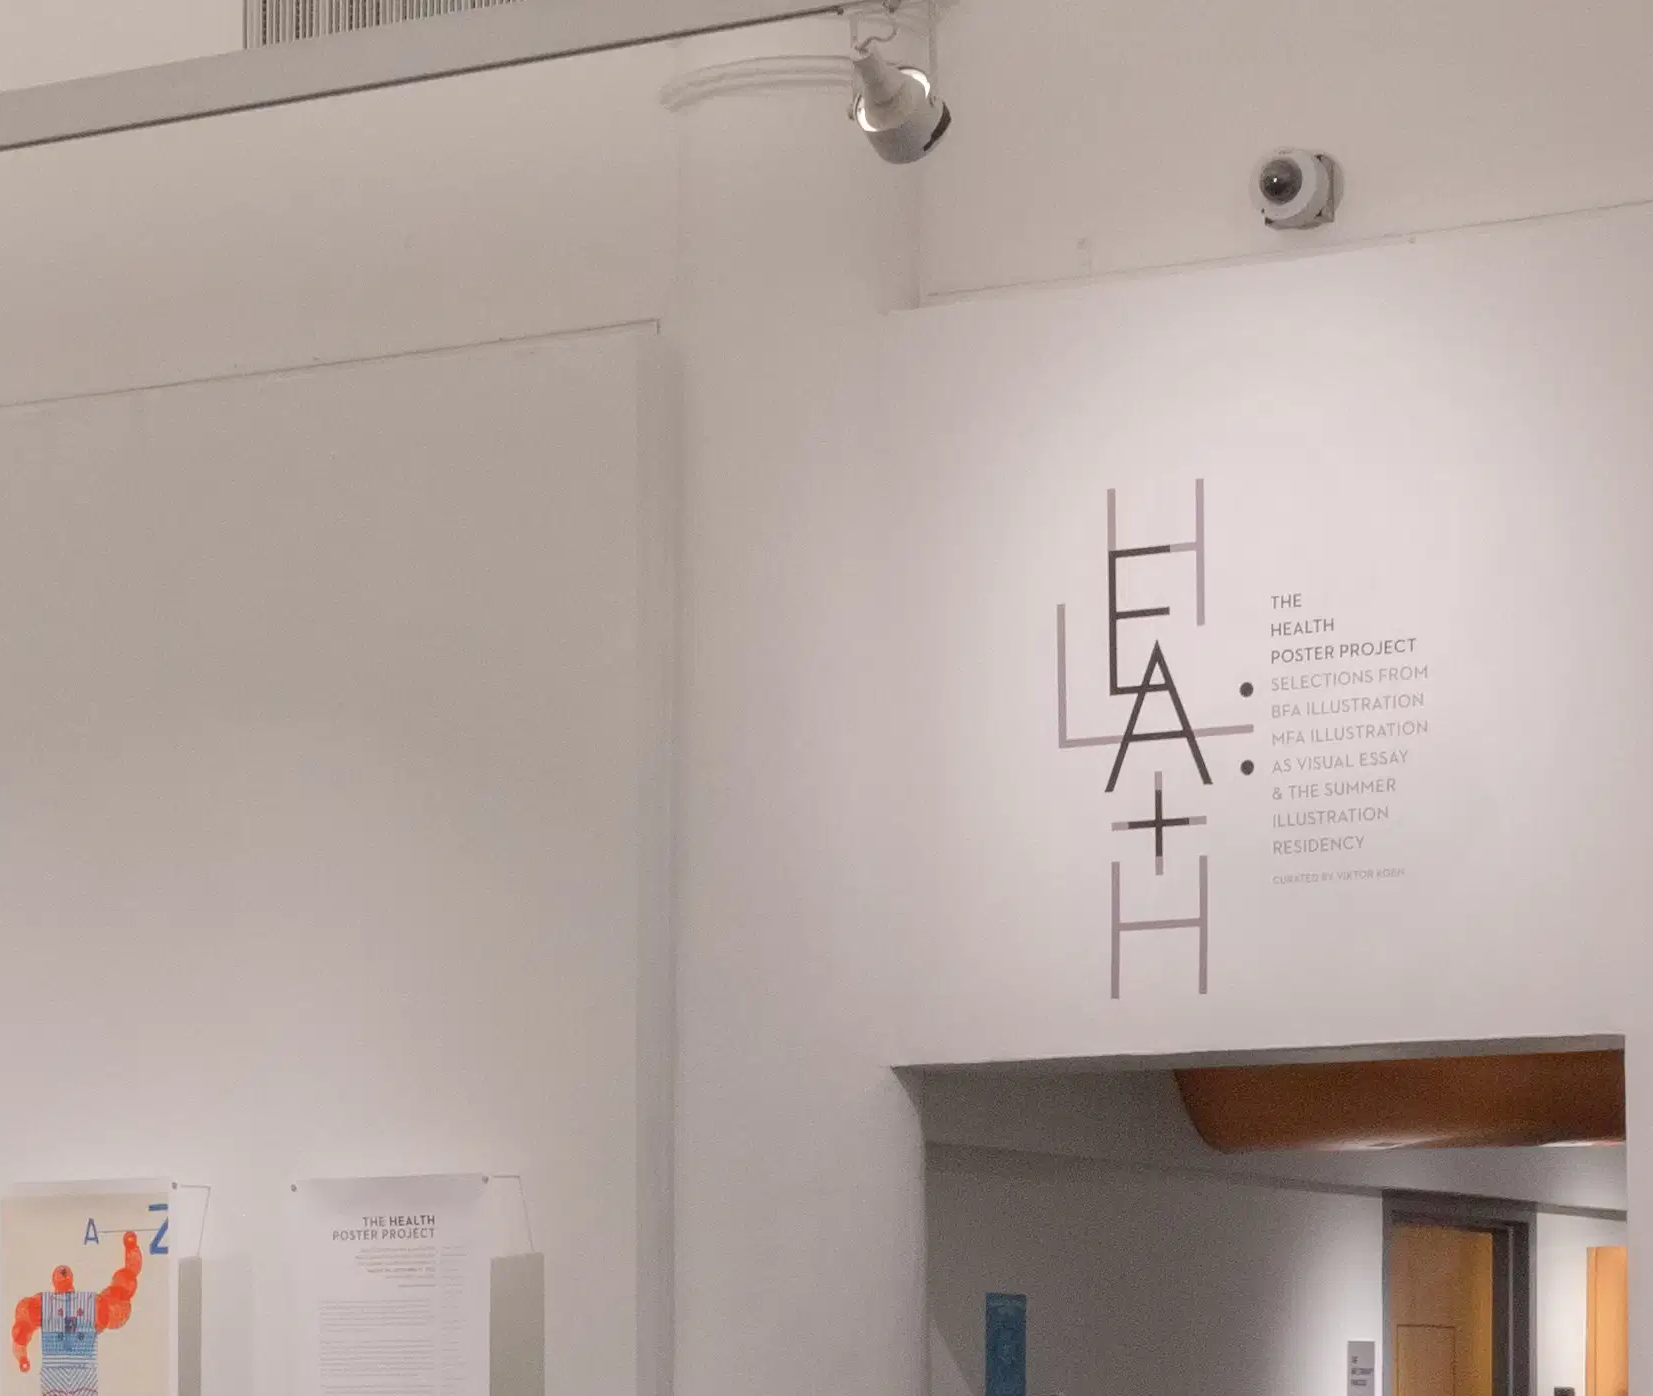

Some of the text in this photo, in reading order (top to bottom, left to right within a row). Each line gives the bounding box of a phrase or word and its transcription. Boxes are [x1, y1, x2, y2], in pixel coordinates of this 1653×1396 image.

[1270, 593, 1302, 609] THE
[1270, 618, 1335, 637] HEALTH
[1271, 637, 1417, 664] POSTER PROJECT
[1271, 664, 1429, 692] SELECTIONS FROM
[1271, 692, 1425, 718] BFA ILLUSTRATION
[1271, 719, 1429, 746] MFA ILLUSTRATION
[1272, 749, 1410, 774] AS VISUAL ESSAY
[1272, 777, 1397, 800] & THE SUMMER
[1272, 805, 1390, 829] ILLUSTRATION
[1272, 835, 1365, 855] RESIDENCY
[84, 1217, 99, 1245] A
[362, 1214, 435, 1227] THE HEALTH
[332, 1227, 435, 1241] POSTER PROJECT
